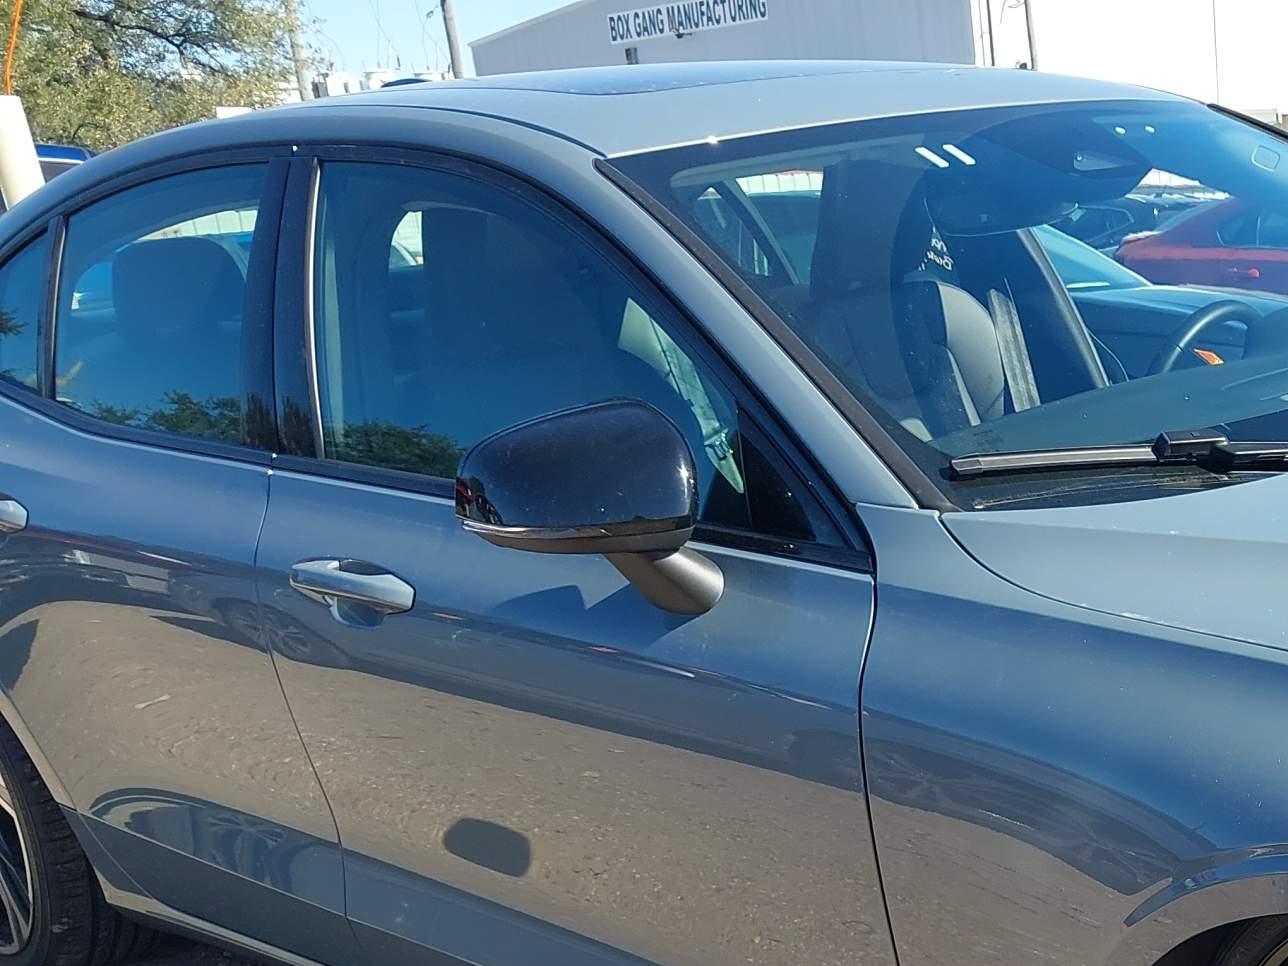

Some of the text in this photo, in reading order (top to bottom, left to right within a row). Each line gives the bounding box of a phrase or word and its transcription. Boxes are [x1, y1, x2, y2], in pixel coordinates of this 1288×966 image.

[608, 0, 767, 42] BOX GANG MANUFACTURING
